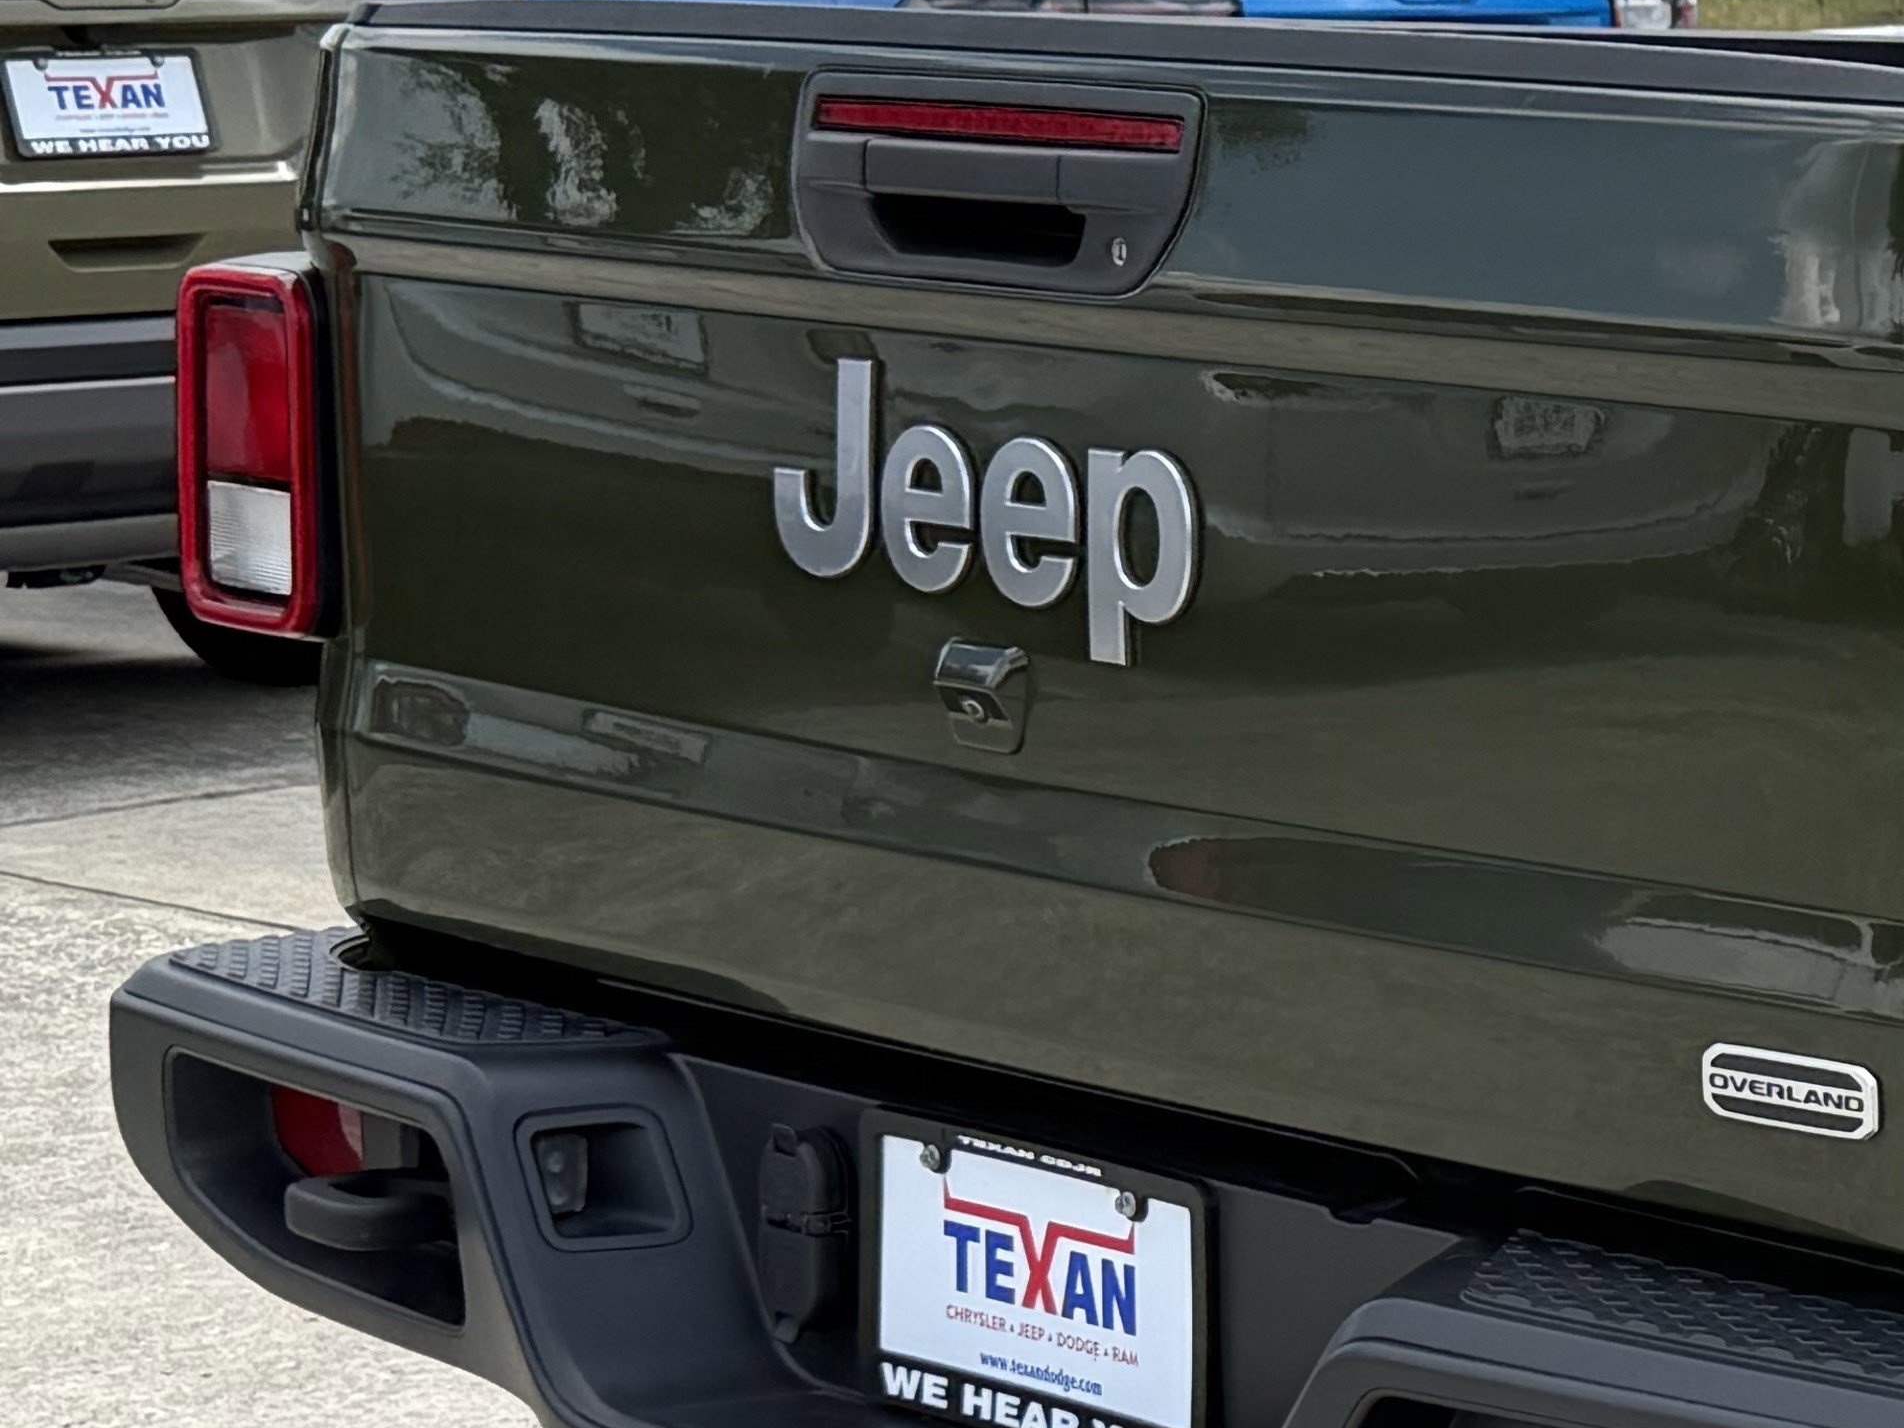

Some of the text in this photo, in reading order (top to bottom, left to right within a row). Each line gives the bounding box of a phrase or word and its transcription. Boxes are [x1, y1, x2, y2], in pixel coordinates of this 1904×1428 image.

[47, 79, 166, 110] TEXAN
[31, 134, 210, 155] WE HEAR YOU
[774, 357, 1205, 666] Jeep
[1709, 1072, 1865, 1113] OVERLAND
[943, 1212, 1137, 1336] TEXAN
[946, 1304, 1139, 1367] CHRYSLER JEEP DODGE RAM
[880, 1361, 949, 1409] WE
